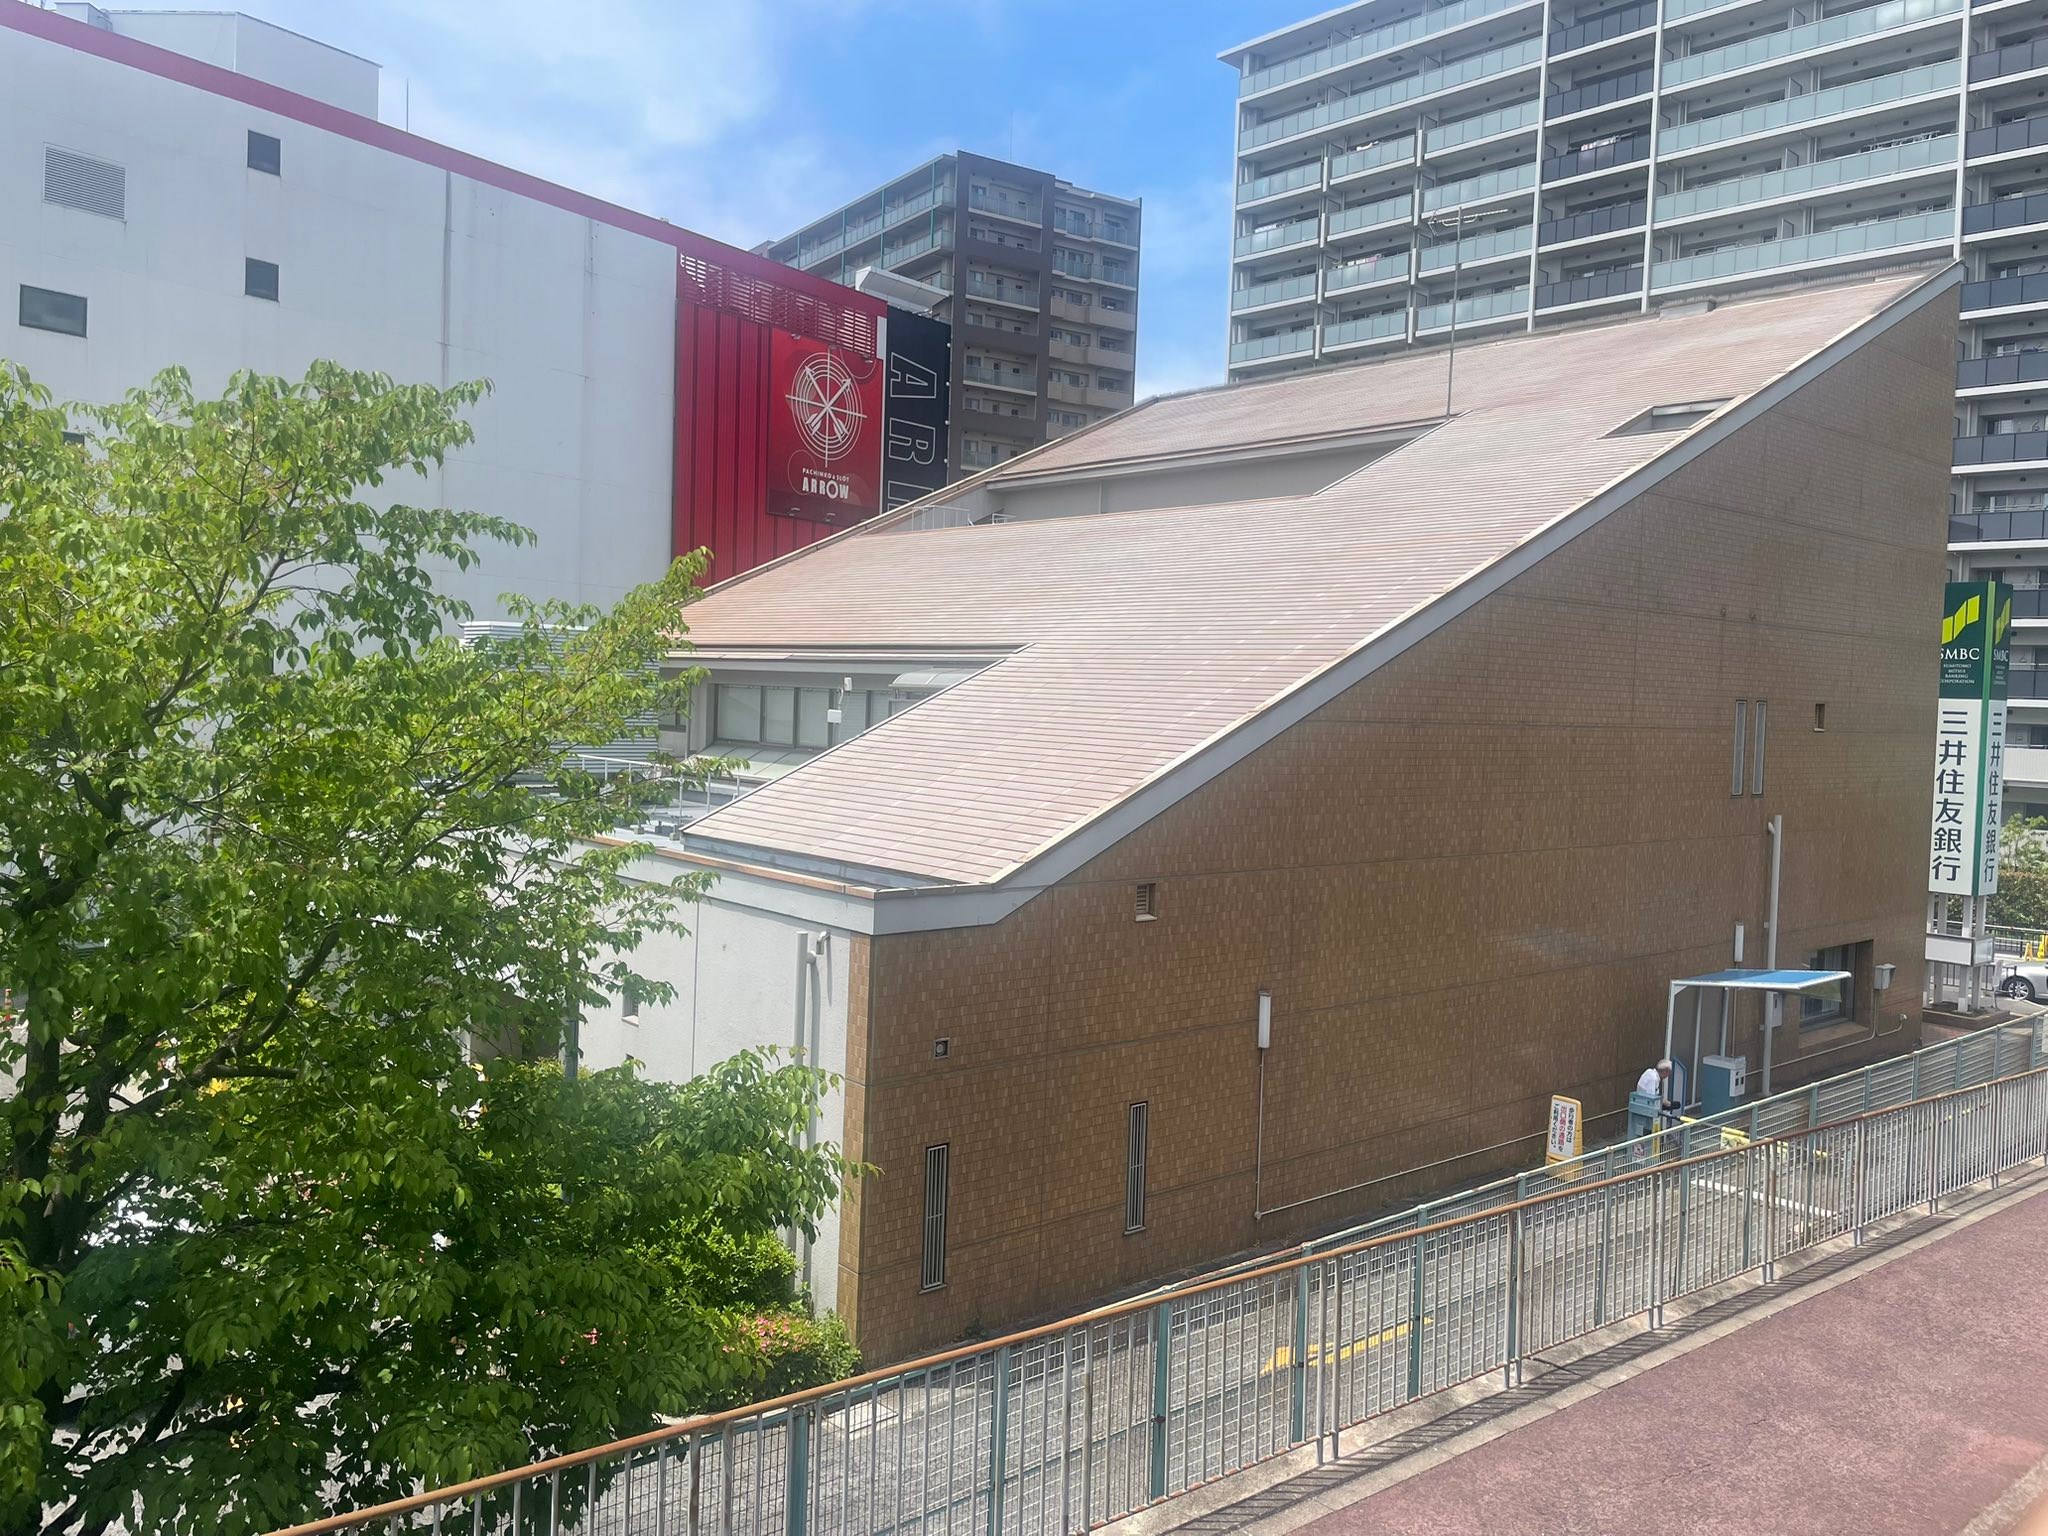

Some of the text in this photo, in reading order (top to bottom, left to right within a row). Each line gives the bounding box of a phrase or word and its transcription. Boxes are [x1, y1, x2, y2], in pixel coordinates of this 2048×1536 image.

[802, 476, 849, 499] ARROW
[1993, 649, 2009, 662] SMBC
[1931, 711, 1968, 882] 三井住友銀行
[1984, 712, 2003, 883] 三井住友銀行
